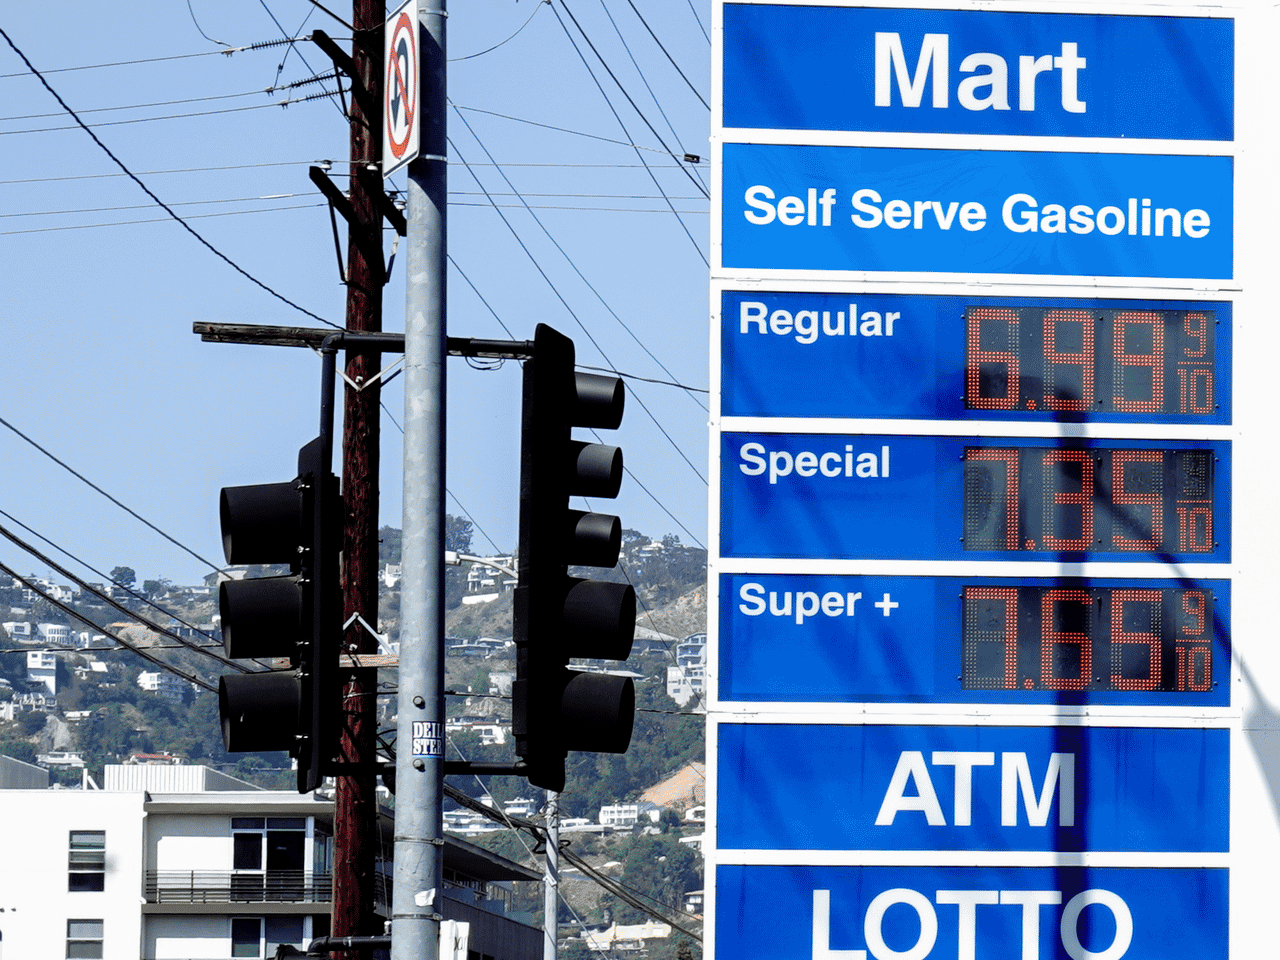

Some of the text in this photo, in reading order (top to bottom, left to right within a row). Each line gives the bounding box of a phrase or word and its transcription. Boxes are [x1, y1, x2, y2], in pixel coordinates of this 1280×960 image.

[873, 31, 1087, 113] Mart
[743, 185, 1211, 238] Self Serve Gasoline
[739, 301, 901, 345] Regular
[965, 308, 1165, 413] 6.99
[739, 443, 891, 484] Special
[967, 449, 1164, 551] 7.35
[739, 583, 862, 624] Super
[874, 593, 899, 617] +
[966, 588, 1162, 691] 7.65
[873, 750, 1076, 827] ATM
